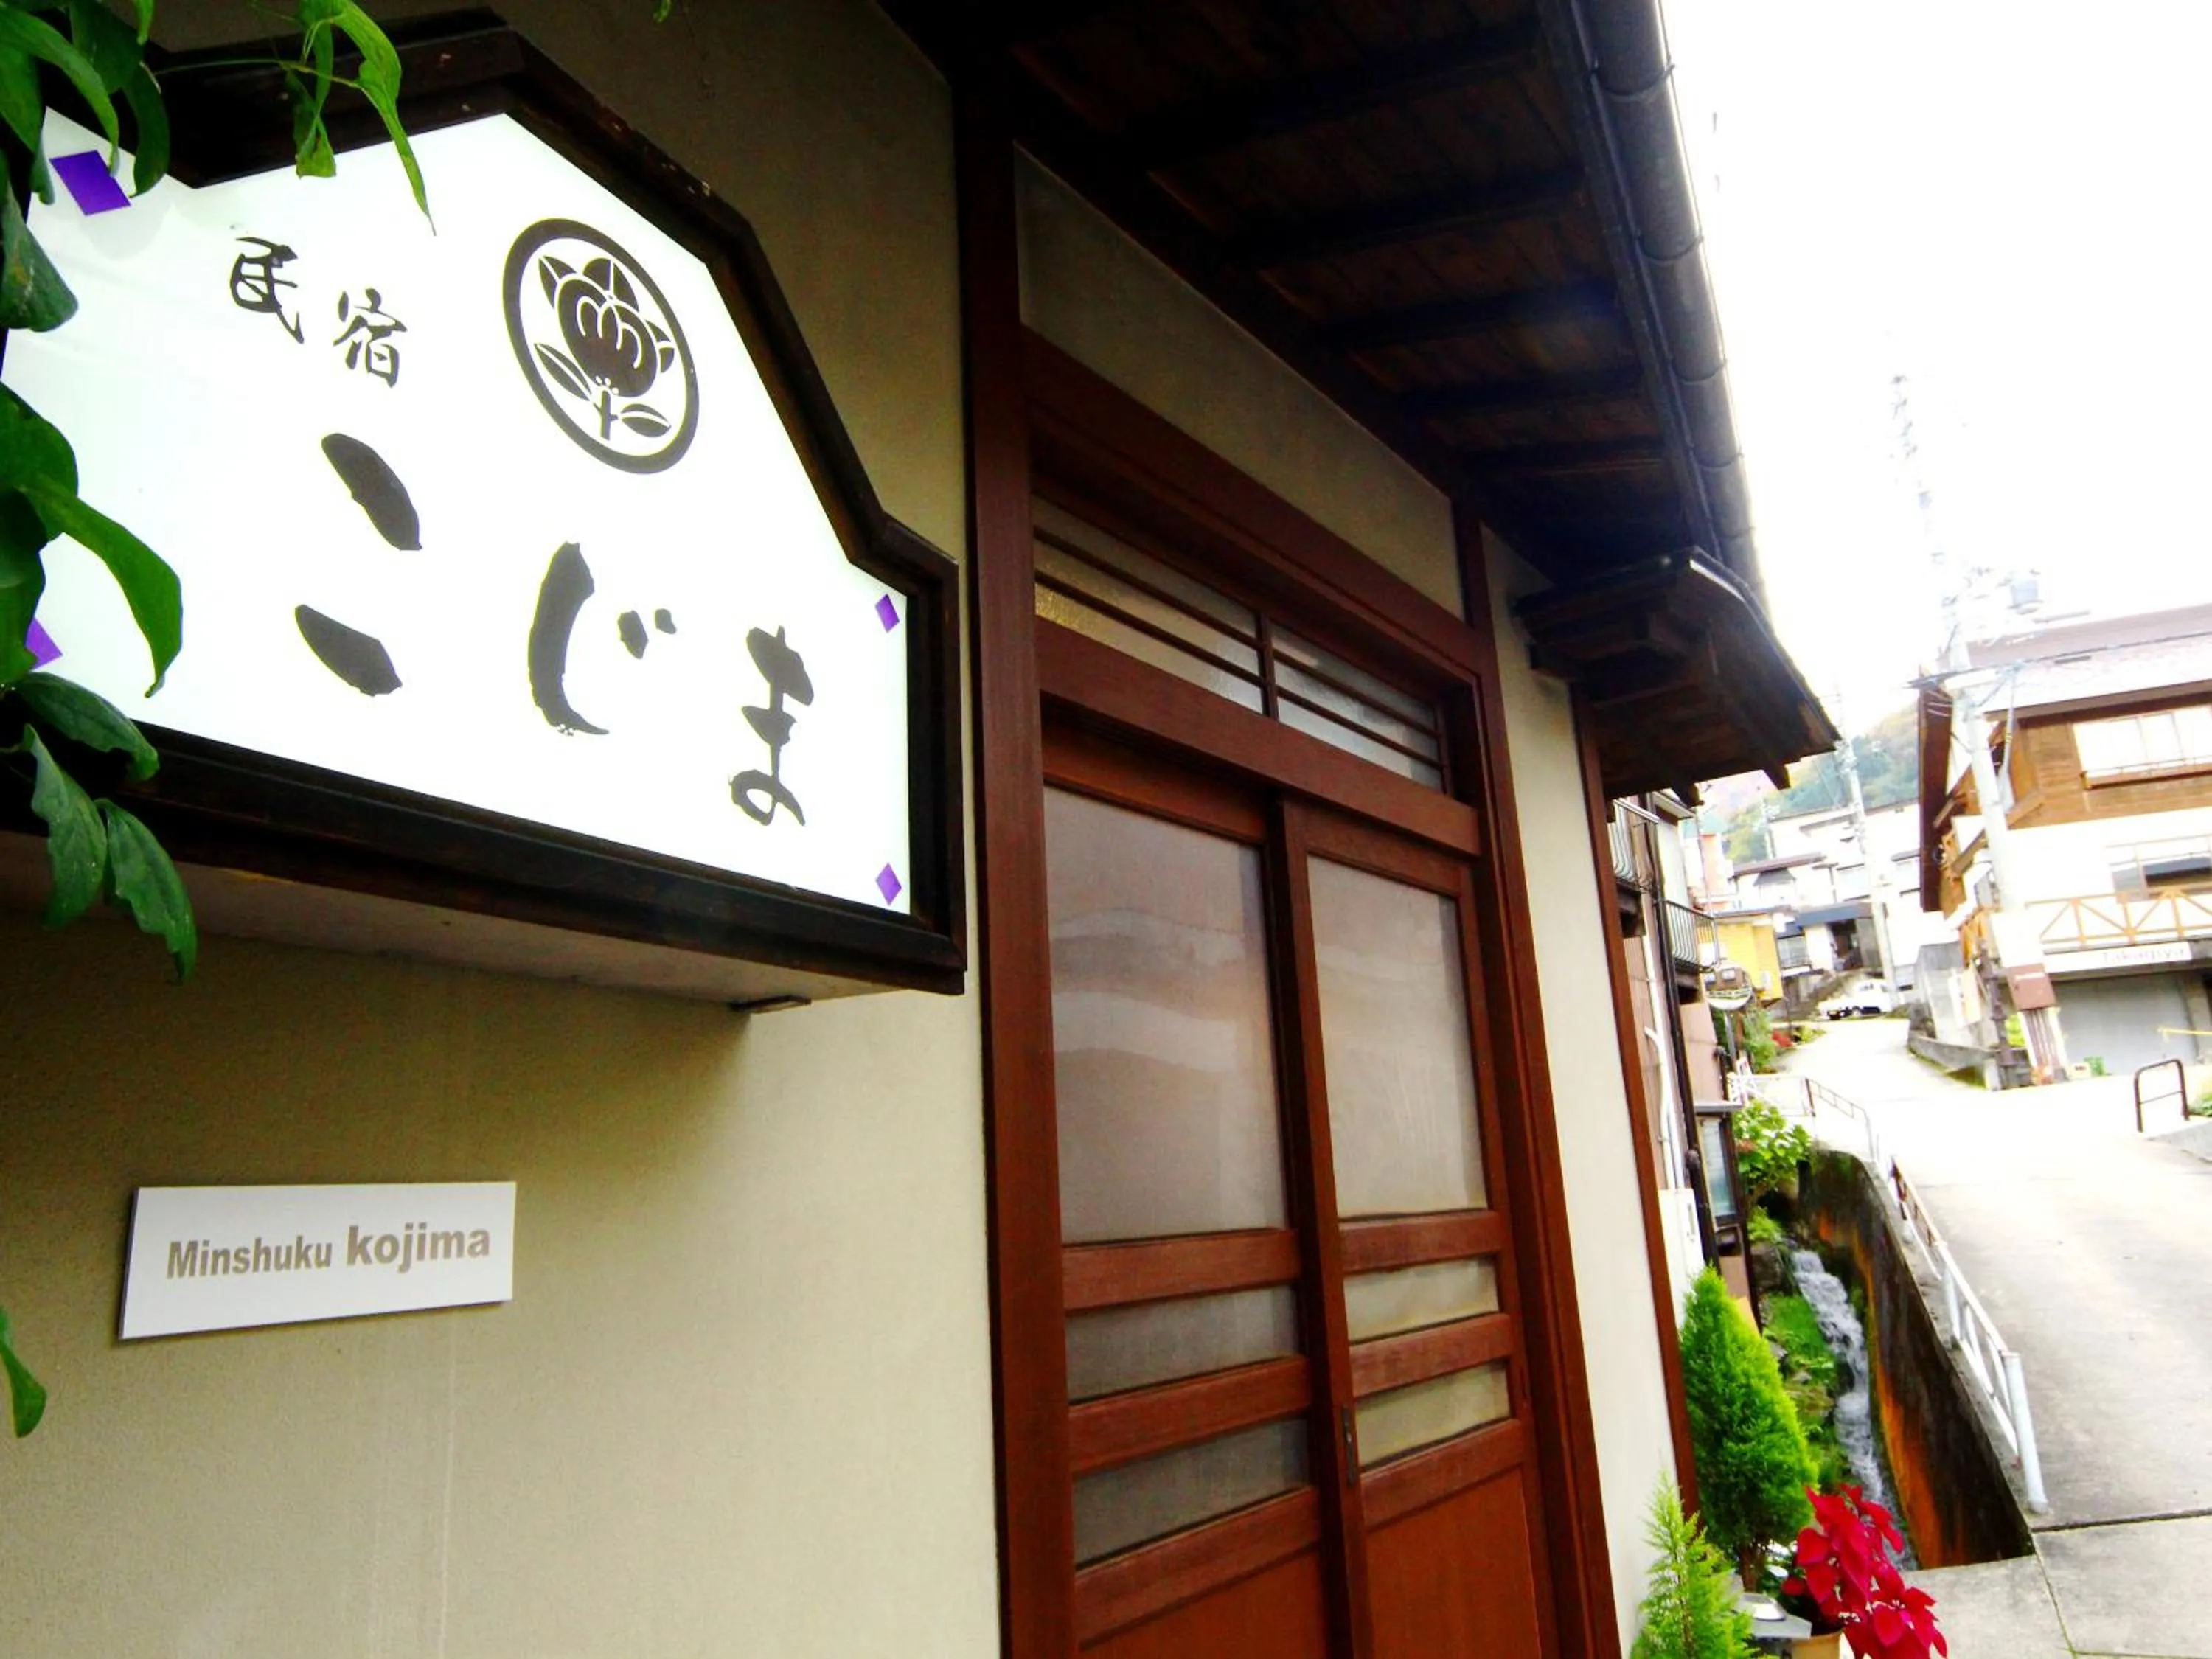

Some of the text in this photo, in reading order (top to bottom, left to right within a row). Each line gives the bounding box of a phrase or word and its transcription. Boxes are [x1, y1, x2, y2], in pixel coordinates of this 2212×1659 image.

[230, 237, 406, 386] 民宿
[296, 434, 813, 824] こじま
[167, 1222, 490, 1279] Minshuku kojima
